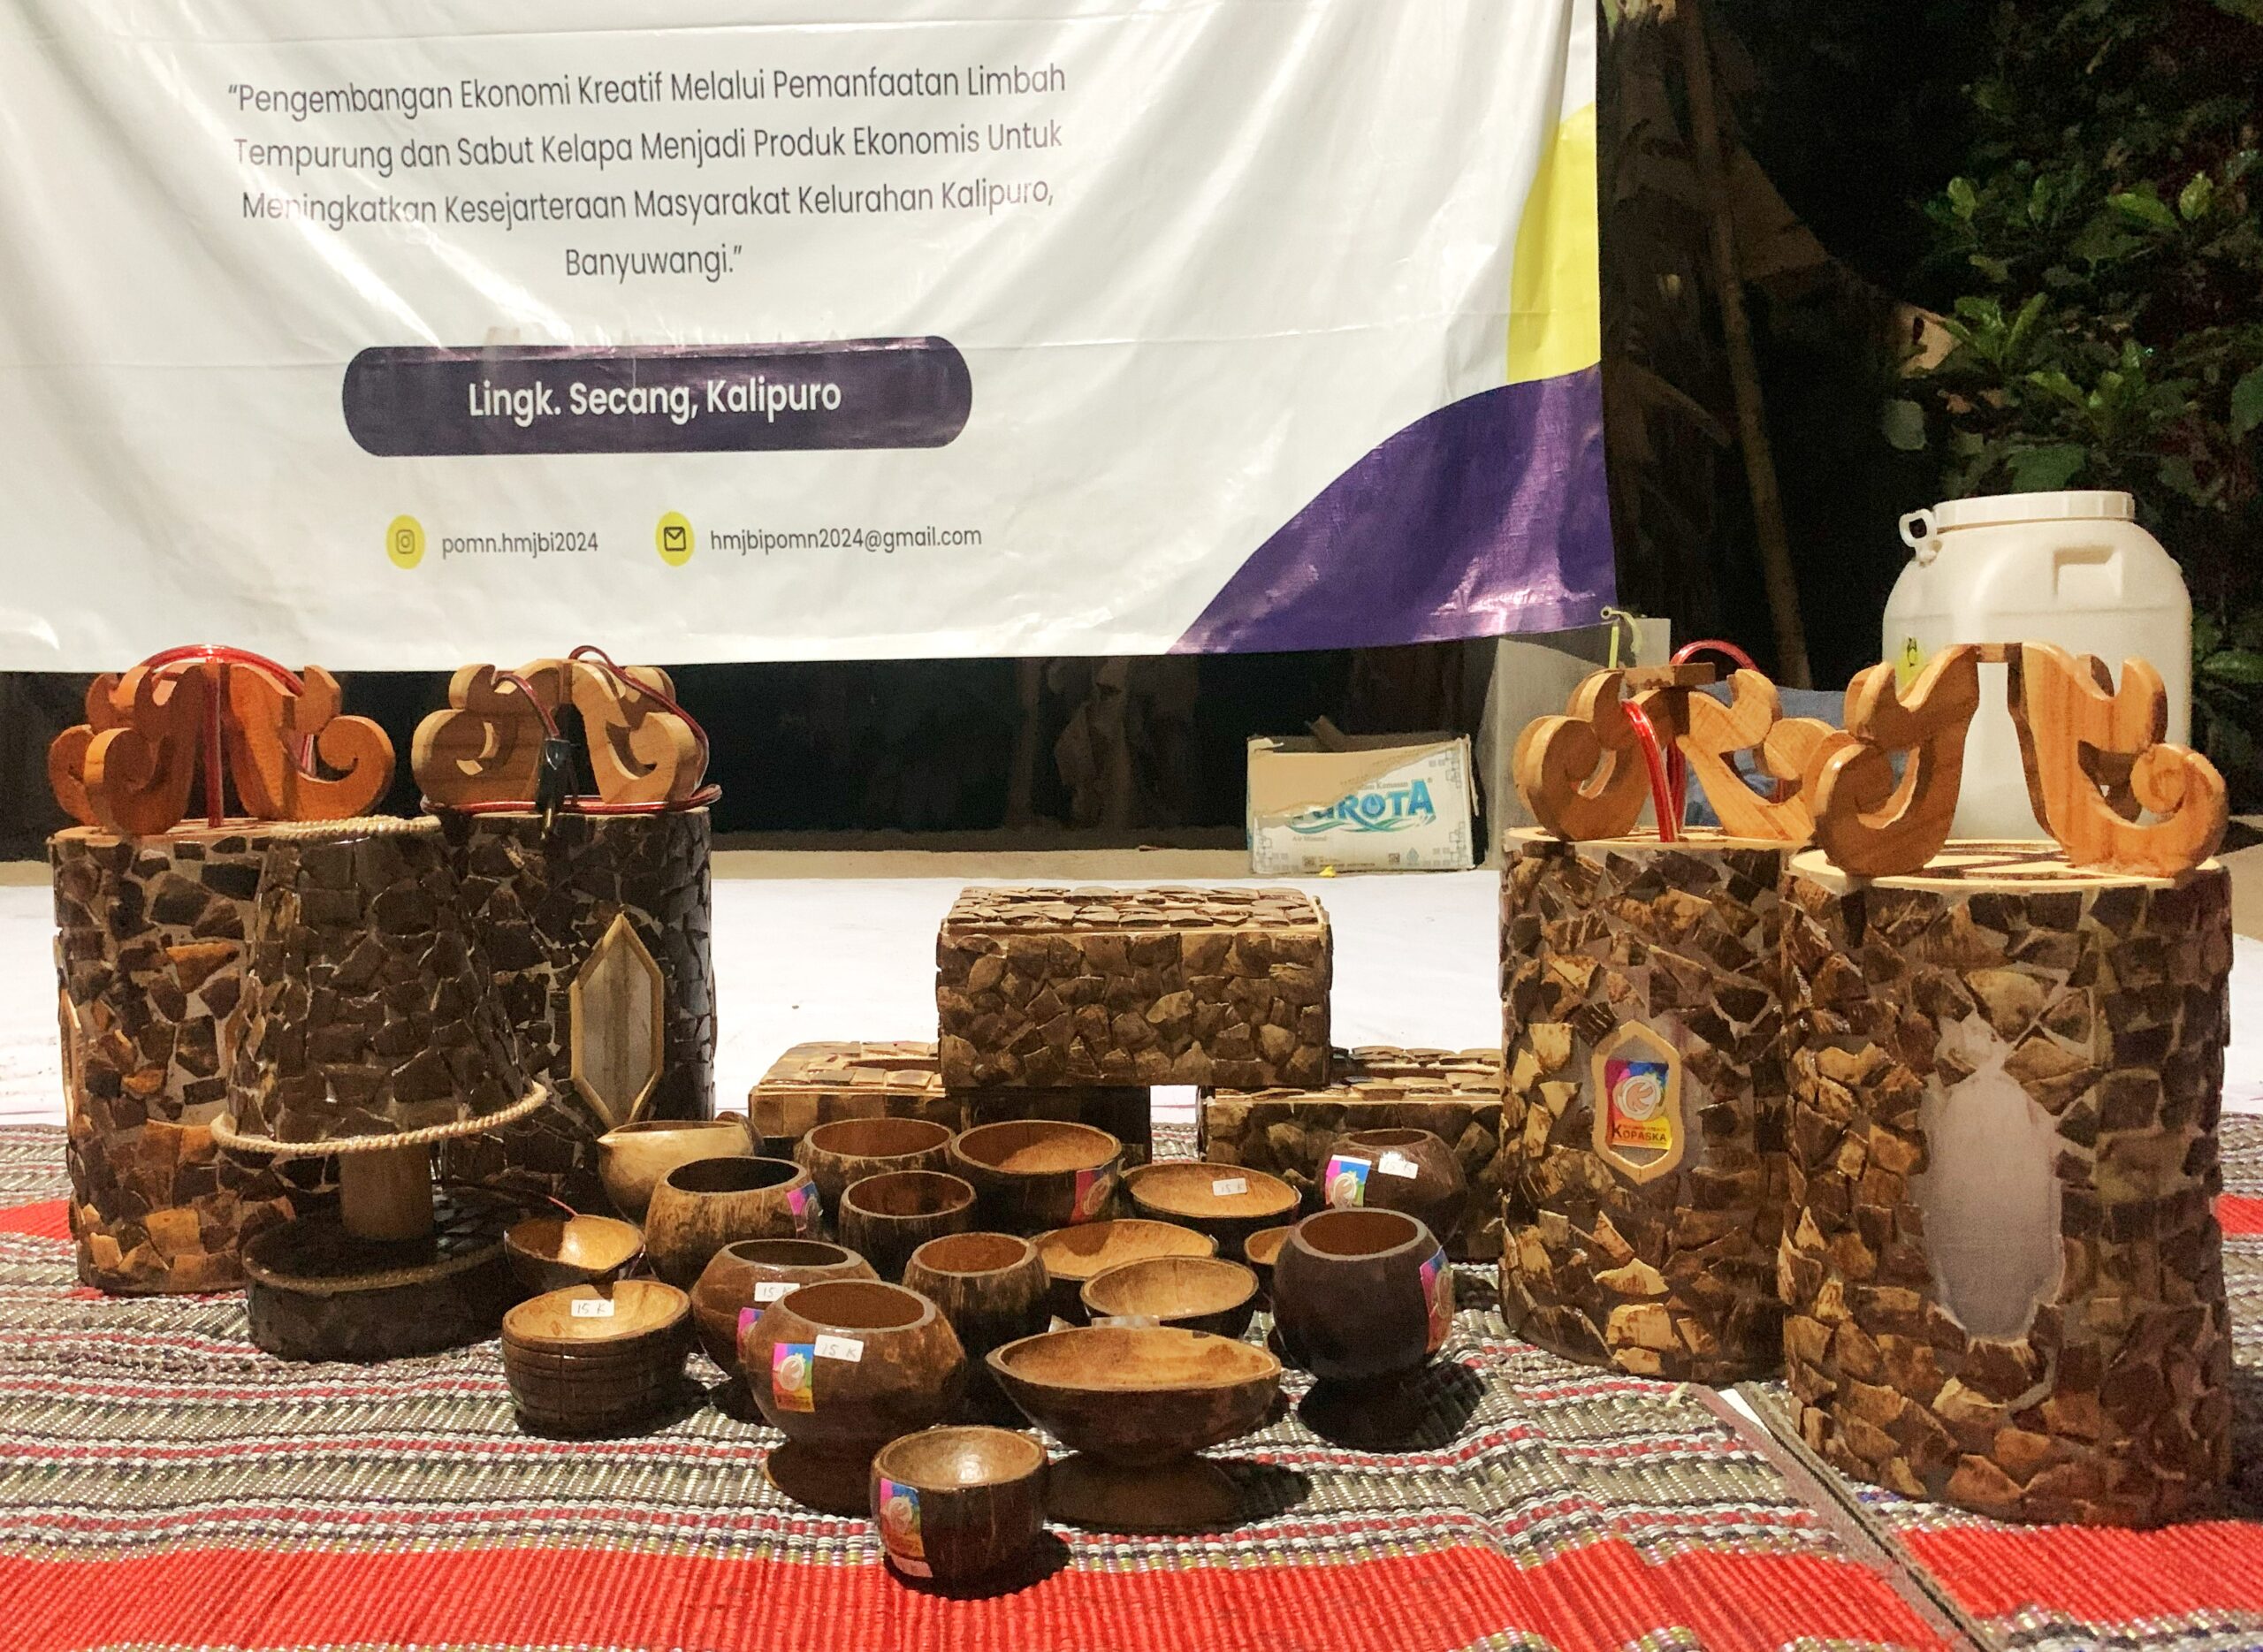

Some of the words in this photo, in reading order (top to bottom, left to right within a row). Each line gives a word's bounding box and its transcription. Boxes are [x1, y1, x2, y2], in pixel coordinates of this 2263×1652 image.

[461, 73, 572, 108] Ekonomi
[577, 71, 664, 104] Kreatif
[671, 68, 766, 102] Melalui
[773, 65, 960, 99] Pemanfaatan
[967, 63, 1066, 96] Limbah
[233, 138, 393, 179] Tempurung
[400, 137, 452, 169] dan
[457, 134, 535, 166] Sabut
[542, 132, 633, 171] Kelapa
[641, 126, 746, 169] Menjadi
[754, 125, 846, 157] Produk
[853, 122, 979, 156] Ekonomis
[988, 118, 1063, 151] Untuk
[242, 191, 437, 232] Meningkatkan
[446, 190, 627, 231] Kesejarteraan
[634, 185, 791, 226] Masyarakat
[798, 183, 933, 215] Kelurahan
[942, 177, 1055, 217] Kalipuro,
[469, 379, 561, 427] Lingk.
[569, 382, 698, 425] Secang,
[707, 376, 842, 423] Kalipuro
[441, 531, 599, 560] pomn.hmjbi2024
[710, 525, 983, 555] hmjbipomn2024@gmail.com
[763, 1286, 775, 1298] 15
[577, 1302, 591, 1315] 15
[597, 1302, 606, 1314] K
[821, 1343, 839, 1357] 15
[846, 1348, 857, 1359] K
